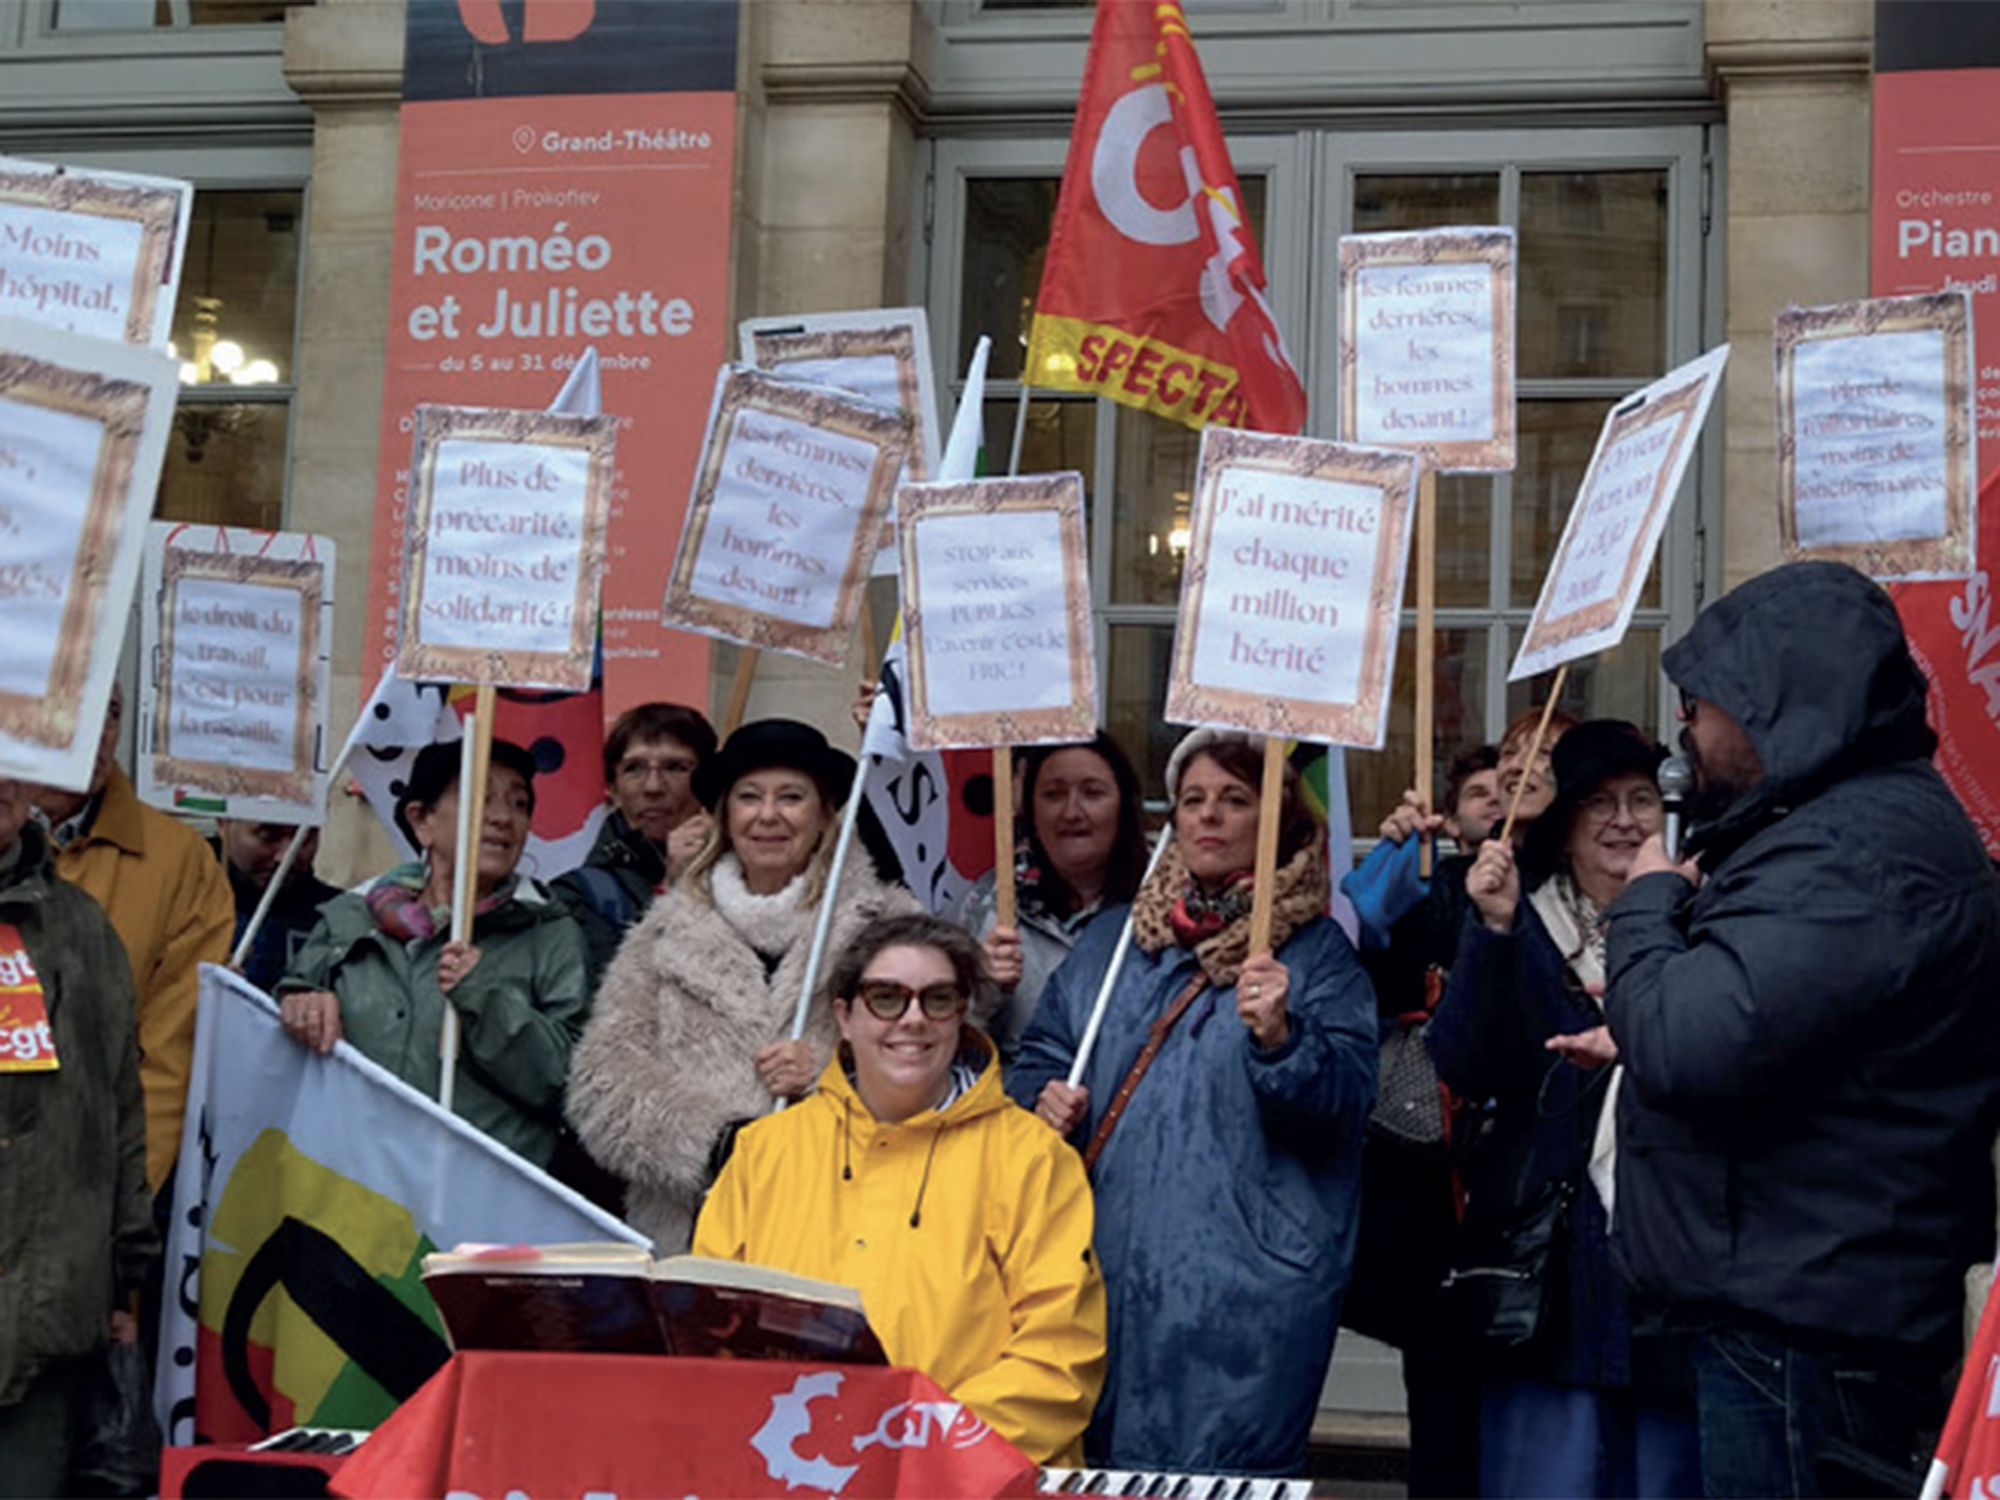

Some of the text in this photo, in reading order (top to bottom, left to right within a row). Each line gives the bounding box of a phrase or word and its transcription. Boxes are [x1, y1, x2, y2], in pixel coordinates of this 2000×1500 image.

[542, 129, 711, 152] Grand-Théâtre
[513, 188, 600, 208] Prokofiev
[1896, 189, 1992, 209] Orchestre
[4, 222, 103, 263] Moins
[413, 222, 611, 275] Roméo
[1898, 218, 2000, 258] Pian
[408, 287, 694, 340] et Juliette
[439, 353, 466, 372] du
[490, 355, 514, 371] au
[521, 352, 545, 371] 31
[551, 352, 651, 371] démbre
[459, 459, 560, 492] Plus de
[1270, 498, 1376, 535] mérité
[434, 550, 568, 584] moins de
[1233, 536, 1350, 583] chaque
[1229, 588, 1339, 628] million
[1228, 630, 1326, 675] hérité
